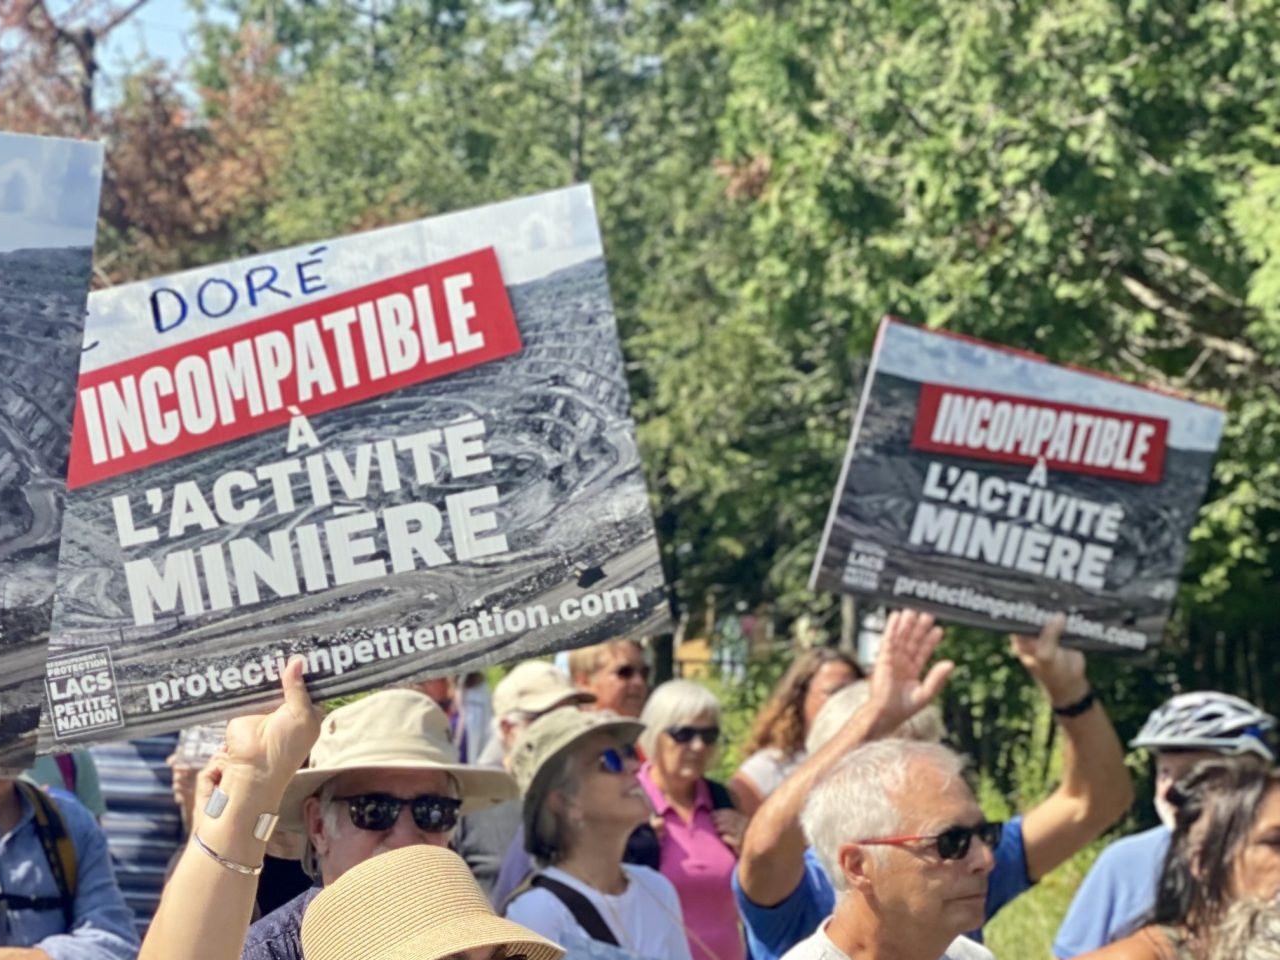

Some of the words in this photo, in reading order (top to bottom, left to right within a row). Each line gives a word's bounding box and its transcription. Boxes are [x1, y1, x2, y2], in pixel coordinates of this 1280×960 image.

[149, 246, 328, 333] DORÉ
[79, 272, 485, 465] INCOMPATIBLE
[286, 407, 320, 453] À
[931, 392, 1155, 474] INCOMPATIBLE
[111, 413, 494, 548] L'ACTIVITÉ
[1027, 455, 1048, 487] À
[124, 486, 509, 627] MINIÈRE
[908, 501, 1114, 590] MINIÈRE
[47, 658, 108, 677] PROTECTION
[49, 672, 112, 700] LACS
[54, 694, 116, 718] PETITE-
[56, 707, 118, 731] NATION
